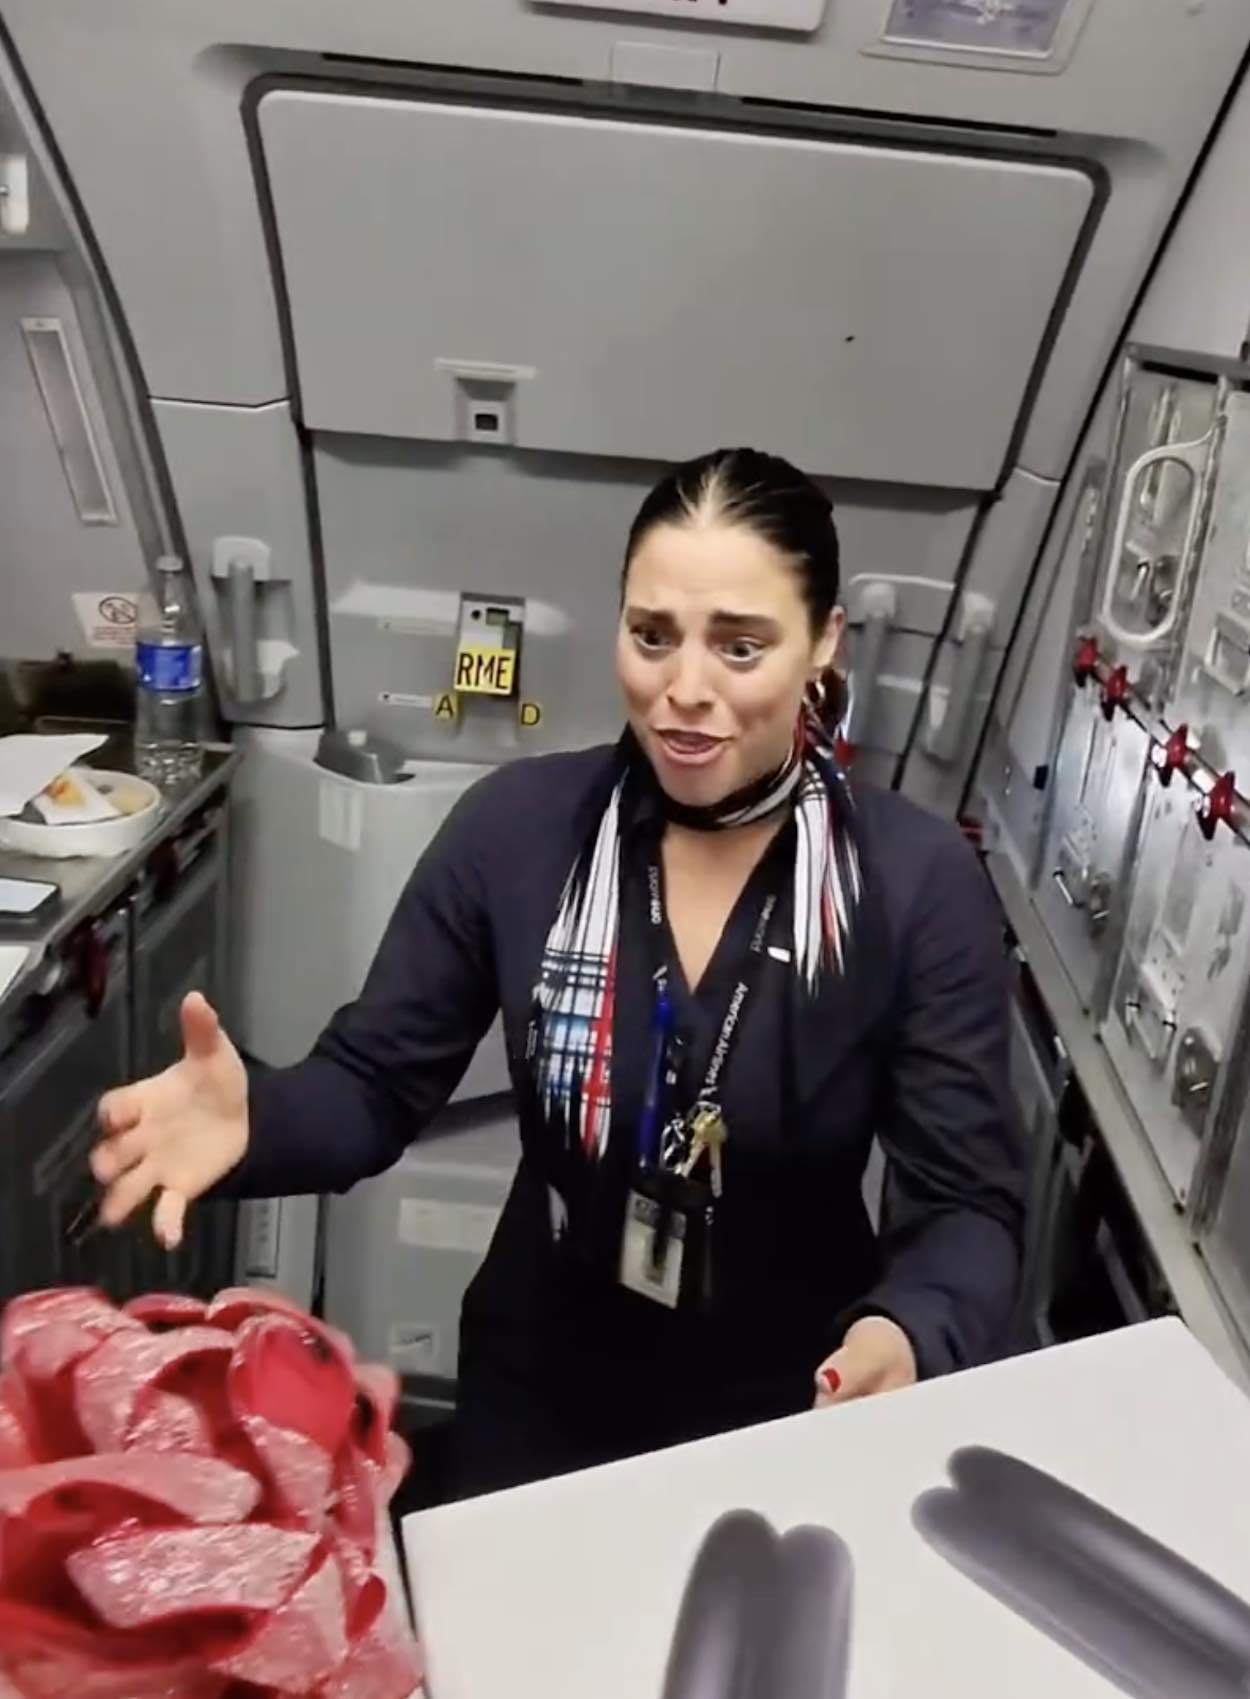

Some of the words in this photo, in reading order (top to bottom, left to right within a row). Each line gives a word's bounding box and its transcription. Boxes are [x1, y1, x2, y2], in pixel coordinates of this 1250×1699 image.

[456, 653, 512, 689] RME
[435, 694, 454, 717] A
[521, 703, 541, 726] D
[720, 981, 749, 1039] American
[705, 1038, 729, 1085] Airlines
